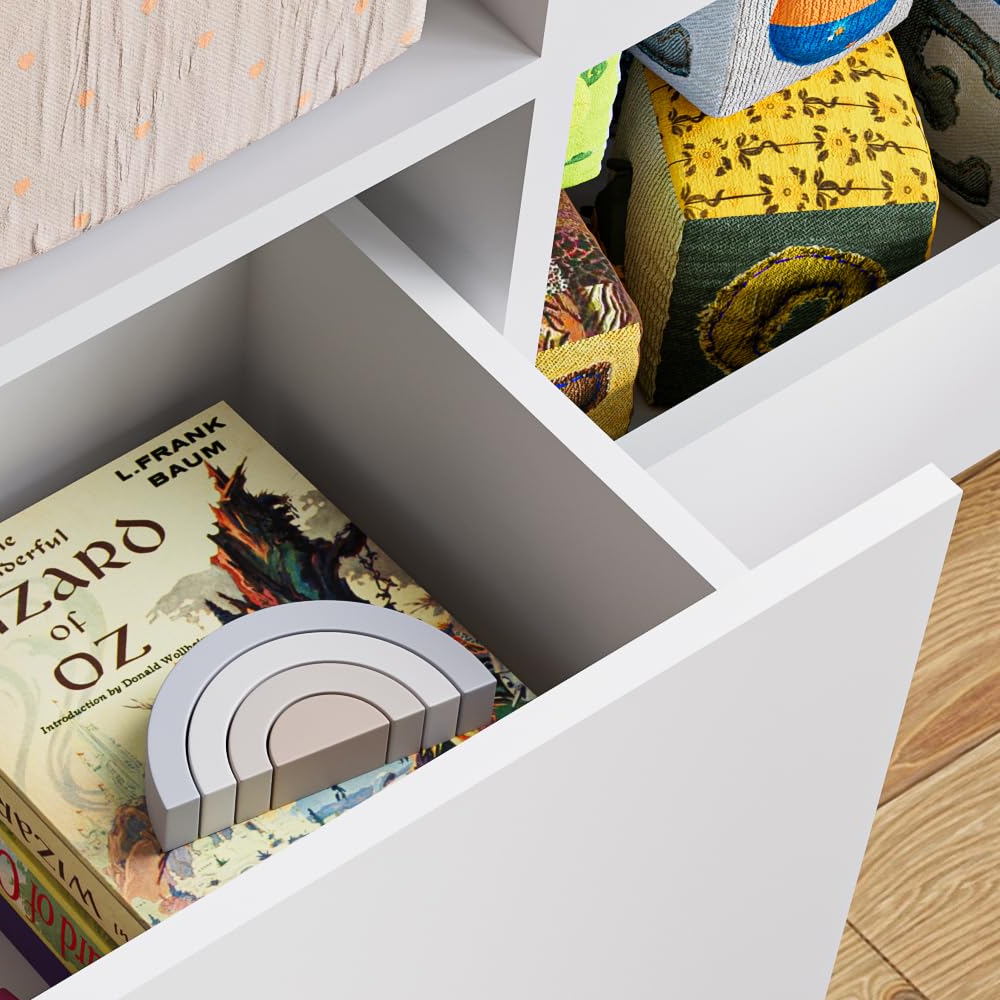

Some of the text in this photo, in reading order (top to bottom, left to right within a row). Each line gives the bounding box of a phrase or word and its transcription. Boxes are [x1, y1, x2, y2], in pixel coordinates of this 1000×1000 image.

[147, 440, 227, 488] BAUM
[50, 610, 86, 641] of
[54, 623, 152, 690] OZ
[40, 694, 108, 735] Introduction
[107, 685, 122, 697] by
[121, 662, 162, 688] Donald
[25, 880, 55, 927] of
